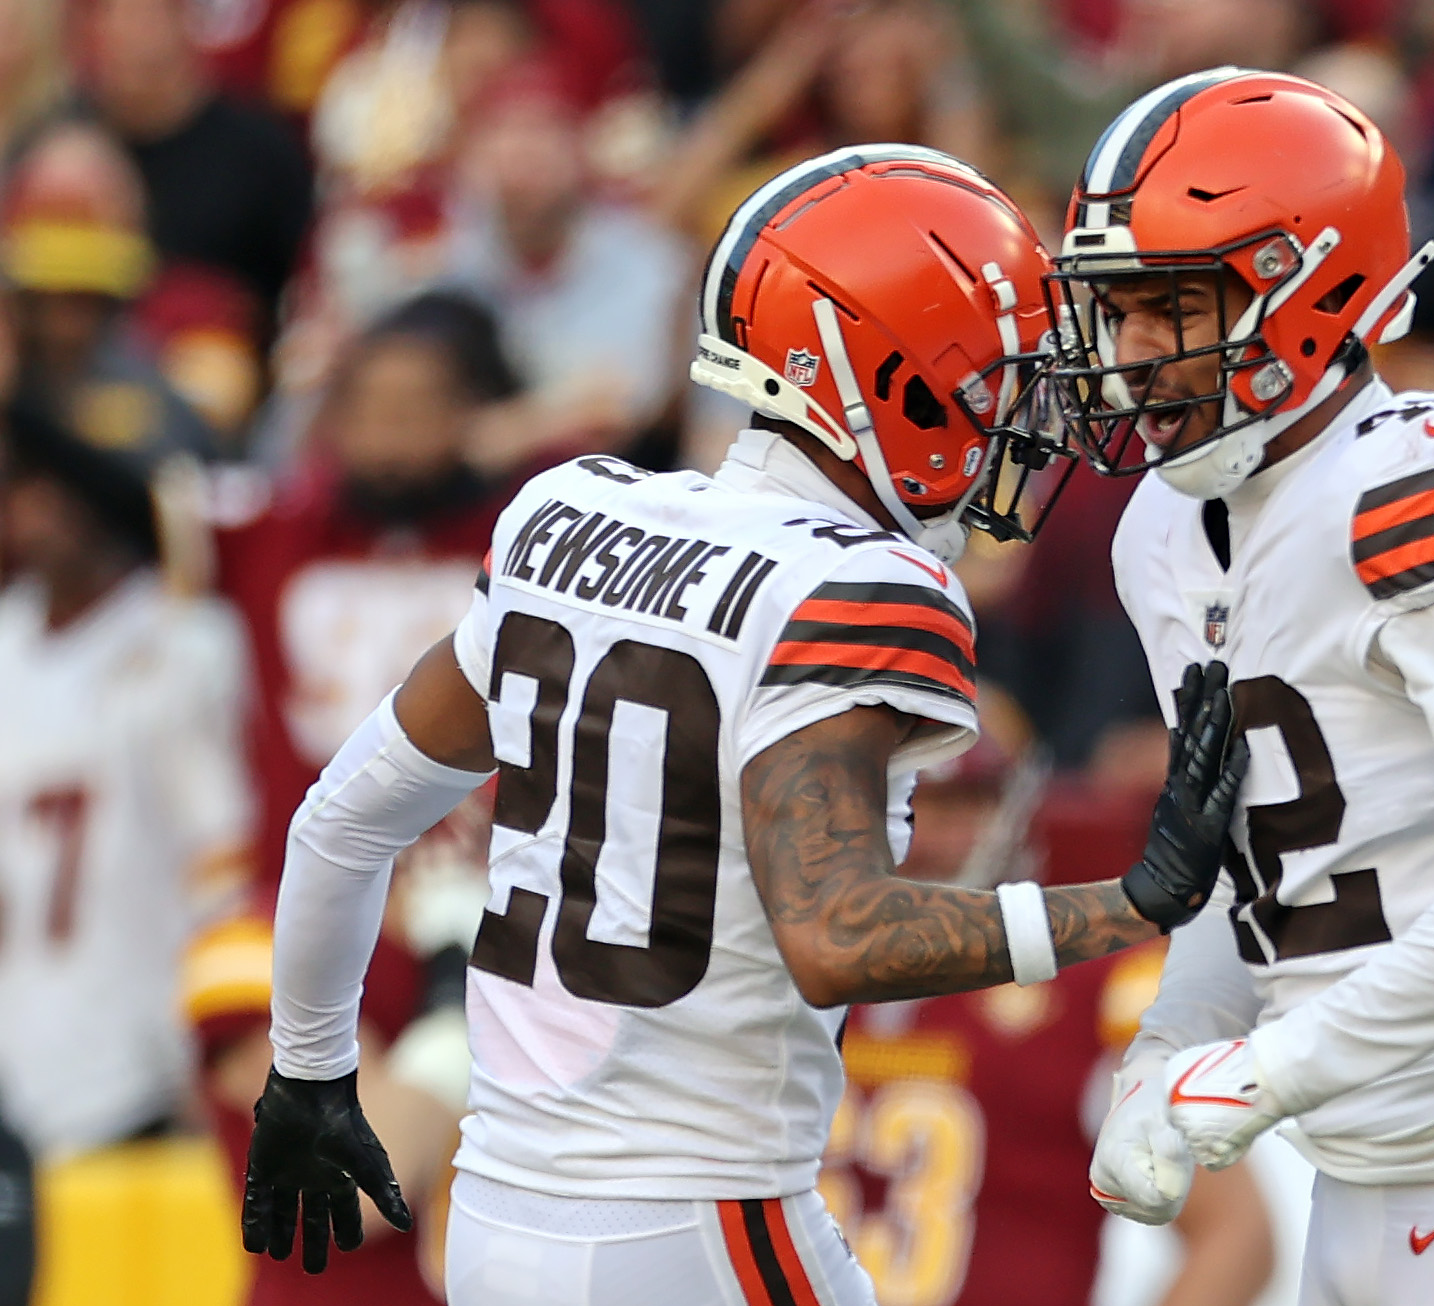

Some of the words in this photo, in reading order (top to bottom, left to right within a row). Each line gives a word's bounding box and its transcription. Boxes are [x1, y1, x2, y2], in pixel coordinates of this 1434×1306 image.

[502, 498, 732, 623] NEWSOME
[706, 550, 779, 641] II
[467, 610, 721, 1010] 20
[1225, 674, 1394, 967] 2
